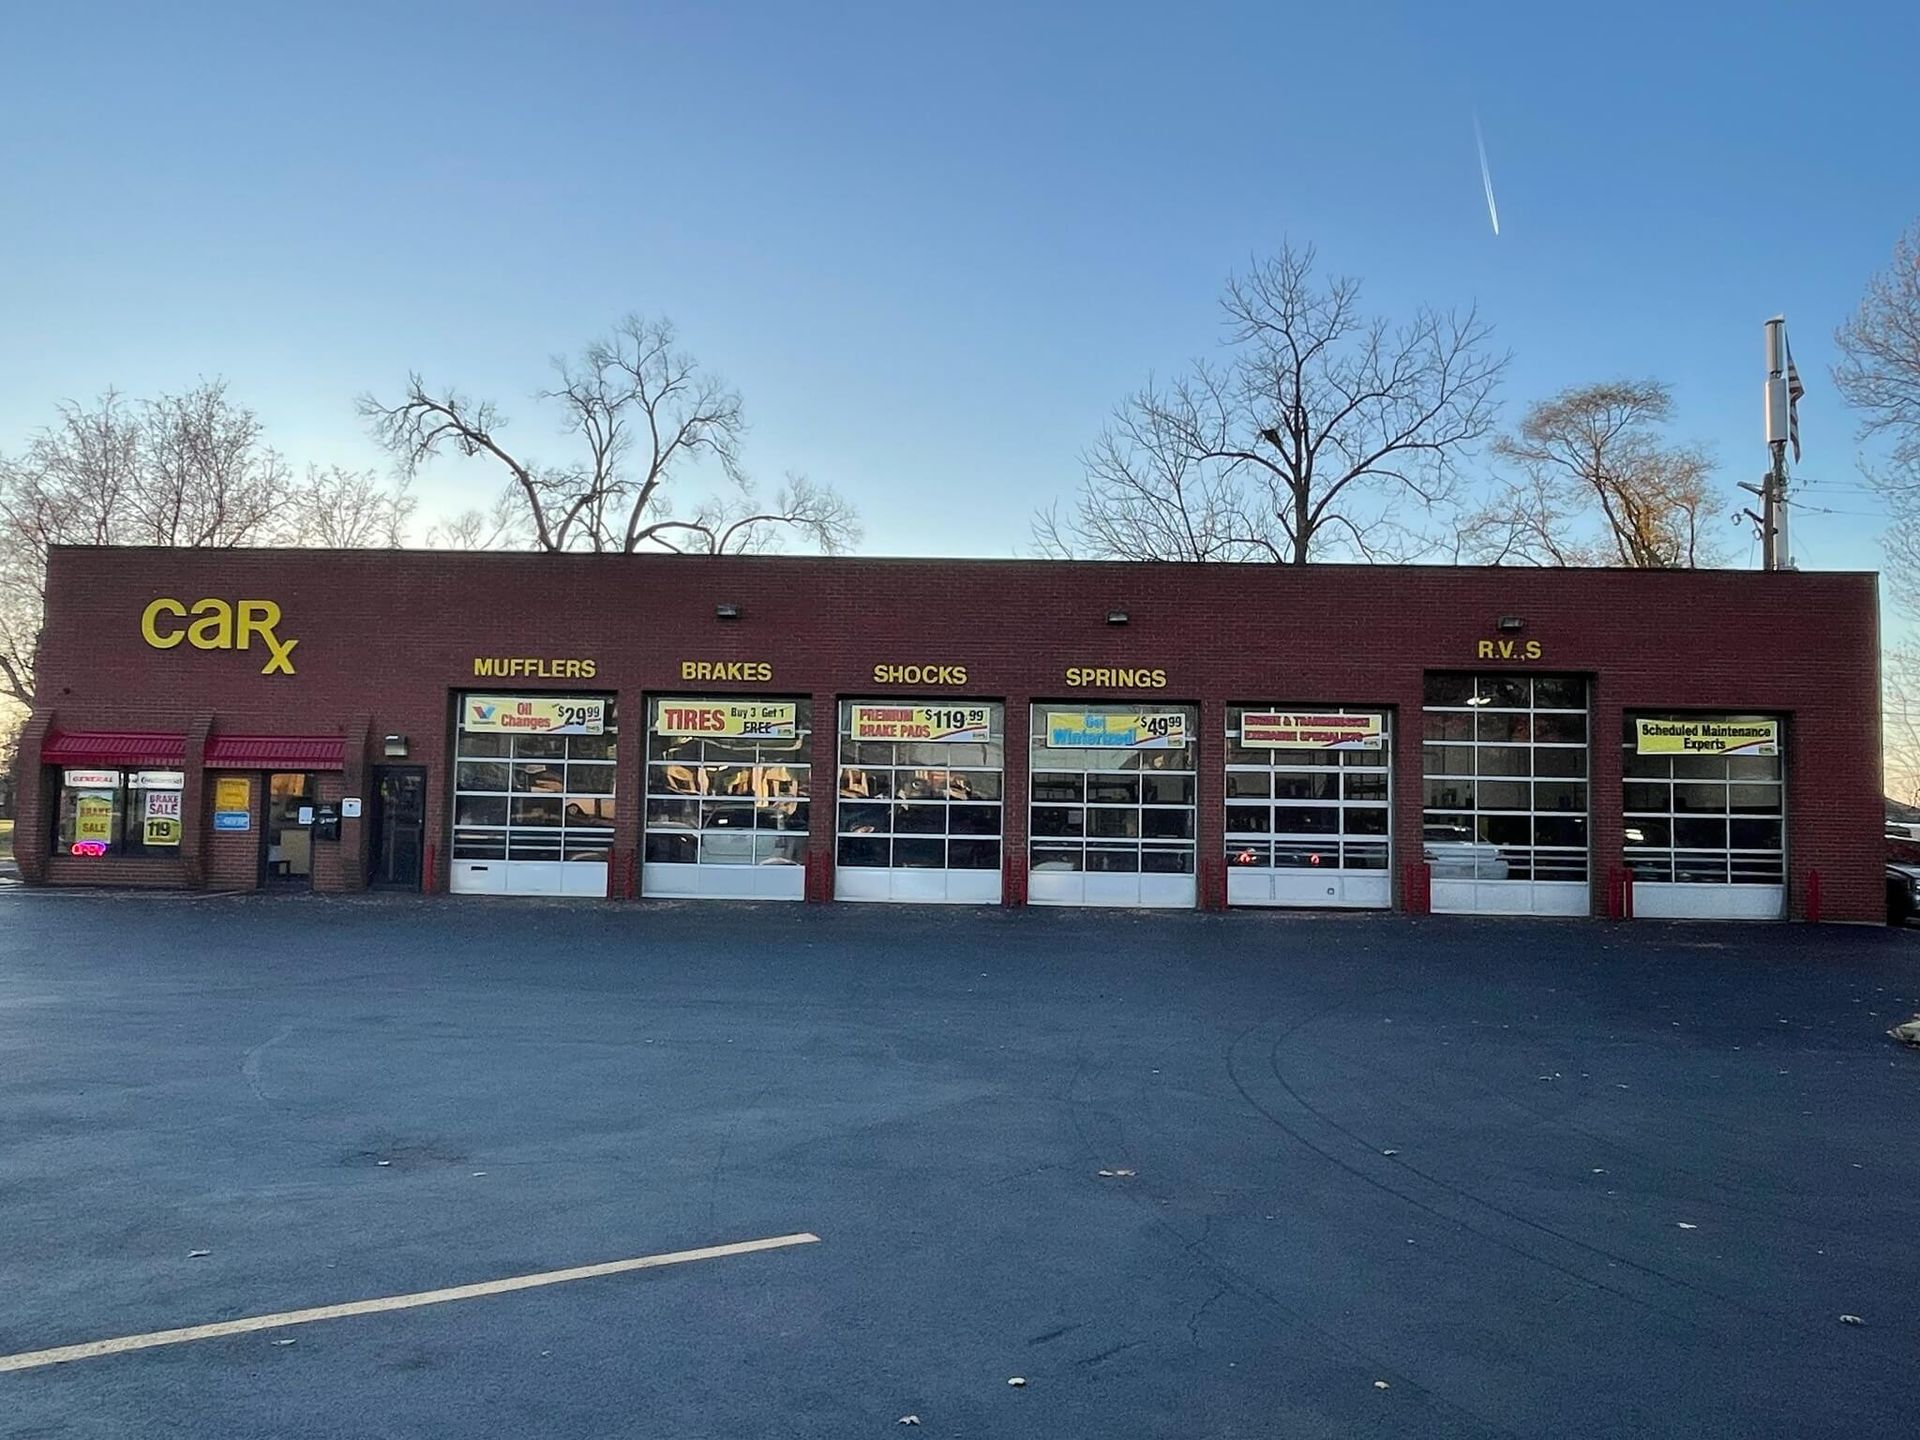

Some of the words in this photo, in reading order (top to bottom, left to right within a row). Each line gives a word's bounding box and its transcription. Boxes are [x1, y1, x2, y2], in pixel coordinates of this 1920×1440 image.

[474, 658, 597, 678] MUFFLERS
[681, 661, 773, 681] BRAKES
[873, 664, 968, 685] SHOCKS
[1065, 667, 1168, 688] SPRINGS
[516, 702, 532, 715] Oil
[730, 707, 748, 719] Buy
[749, 707, 756, 718] 3
[761, 708, 777, 718] Get
[779, 708, 785, 718] 1
[500, 714, 551, 730] Changes
[664, 708, 726, 732] TIRES
[743, 721, 772, 734] FREE
[859, 724, 898, 738] BRAKE
[900, 725, 932, 738] PADS
[1641, 723, 1699, 737] Scheduled
[1701, 724, 1772, 738] Maintenance
[1683, 737, 1727, 752] Experts
[149, 794, 180, 804] BRAKE
[149, 803, 179, 816] SALE
[81, 822, 107, 833] SALE
